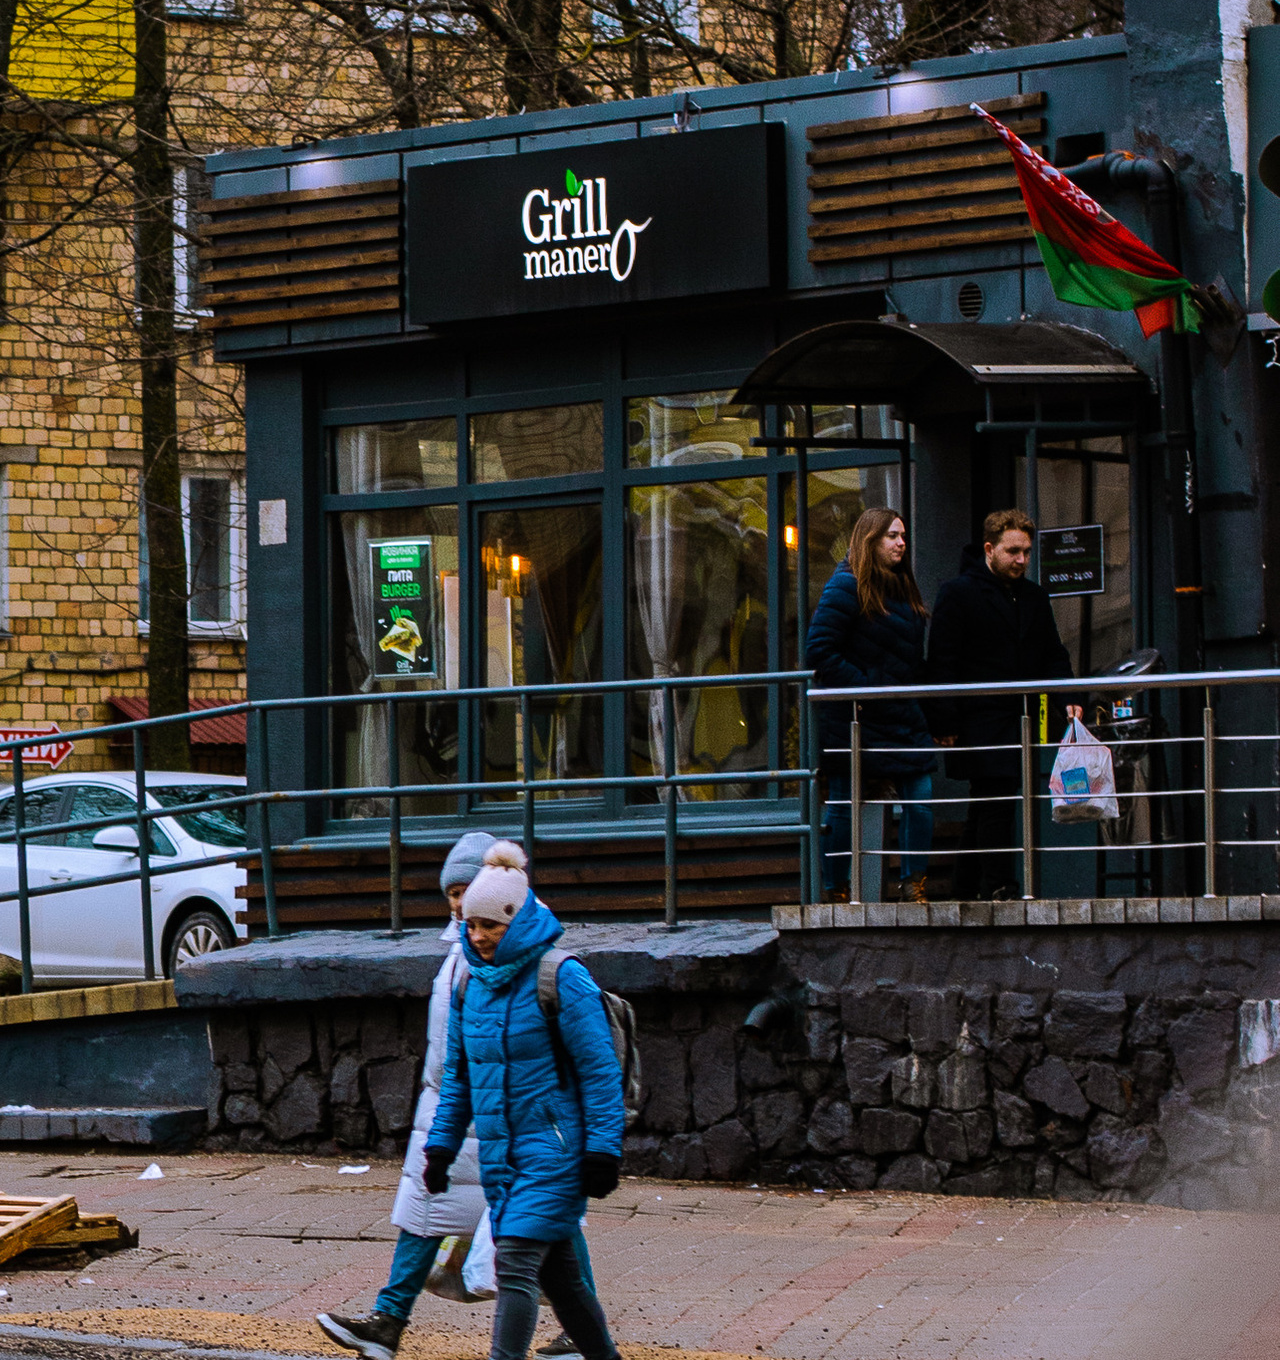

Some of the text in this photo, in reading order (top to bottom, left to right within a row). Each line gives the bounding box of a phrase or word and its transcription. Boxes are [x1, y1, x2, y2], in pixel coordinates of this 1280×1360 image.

[522, 177, 611, 245] Grill
[388, 570, 413, 582] ПИТА
[381, 583, 420, 597] BURGER
